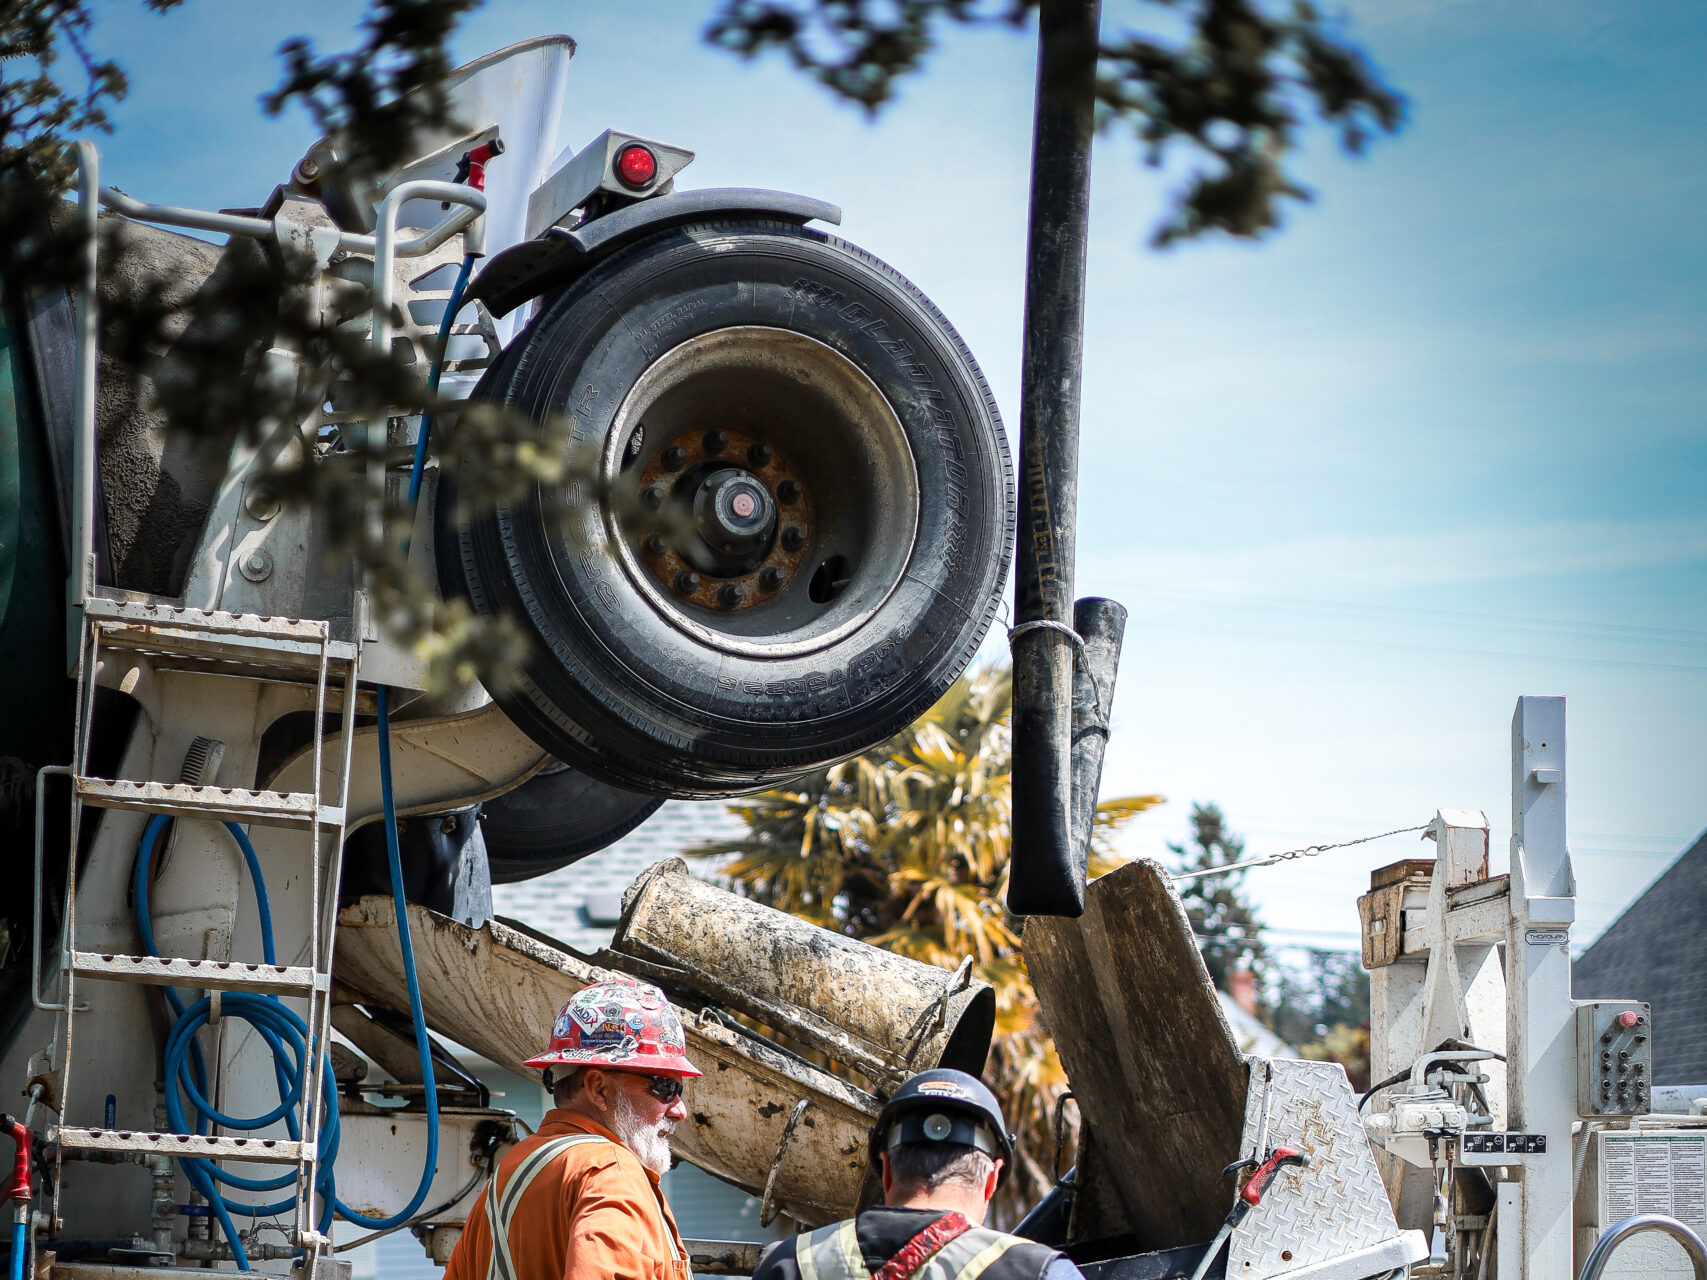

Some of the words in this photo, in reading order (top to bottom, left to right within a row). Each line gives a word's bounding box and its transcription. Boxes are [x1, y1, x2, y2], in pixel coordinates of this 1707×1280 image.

[838, 302, 970, 518] GLADIATOR
[717, 622, 911, 695] 295/75R22.5
[574, 1005, 596, 1028] KADIX
